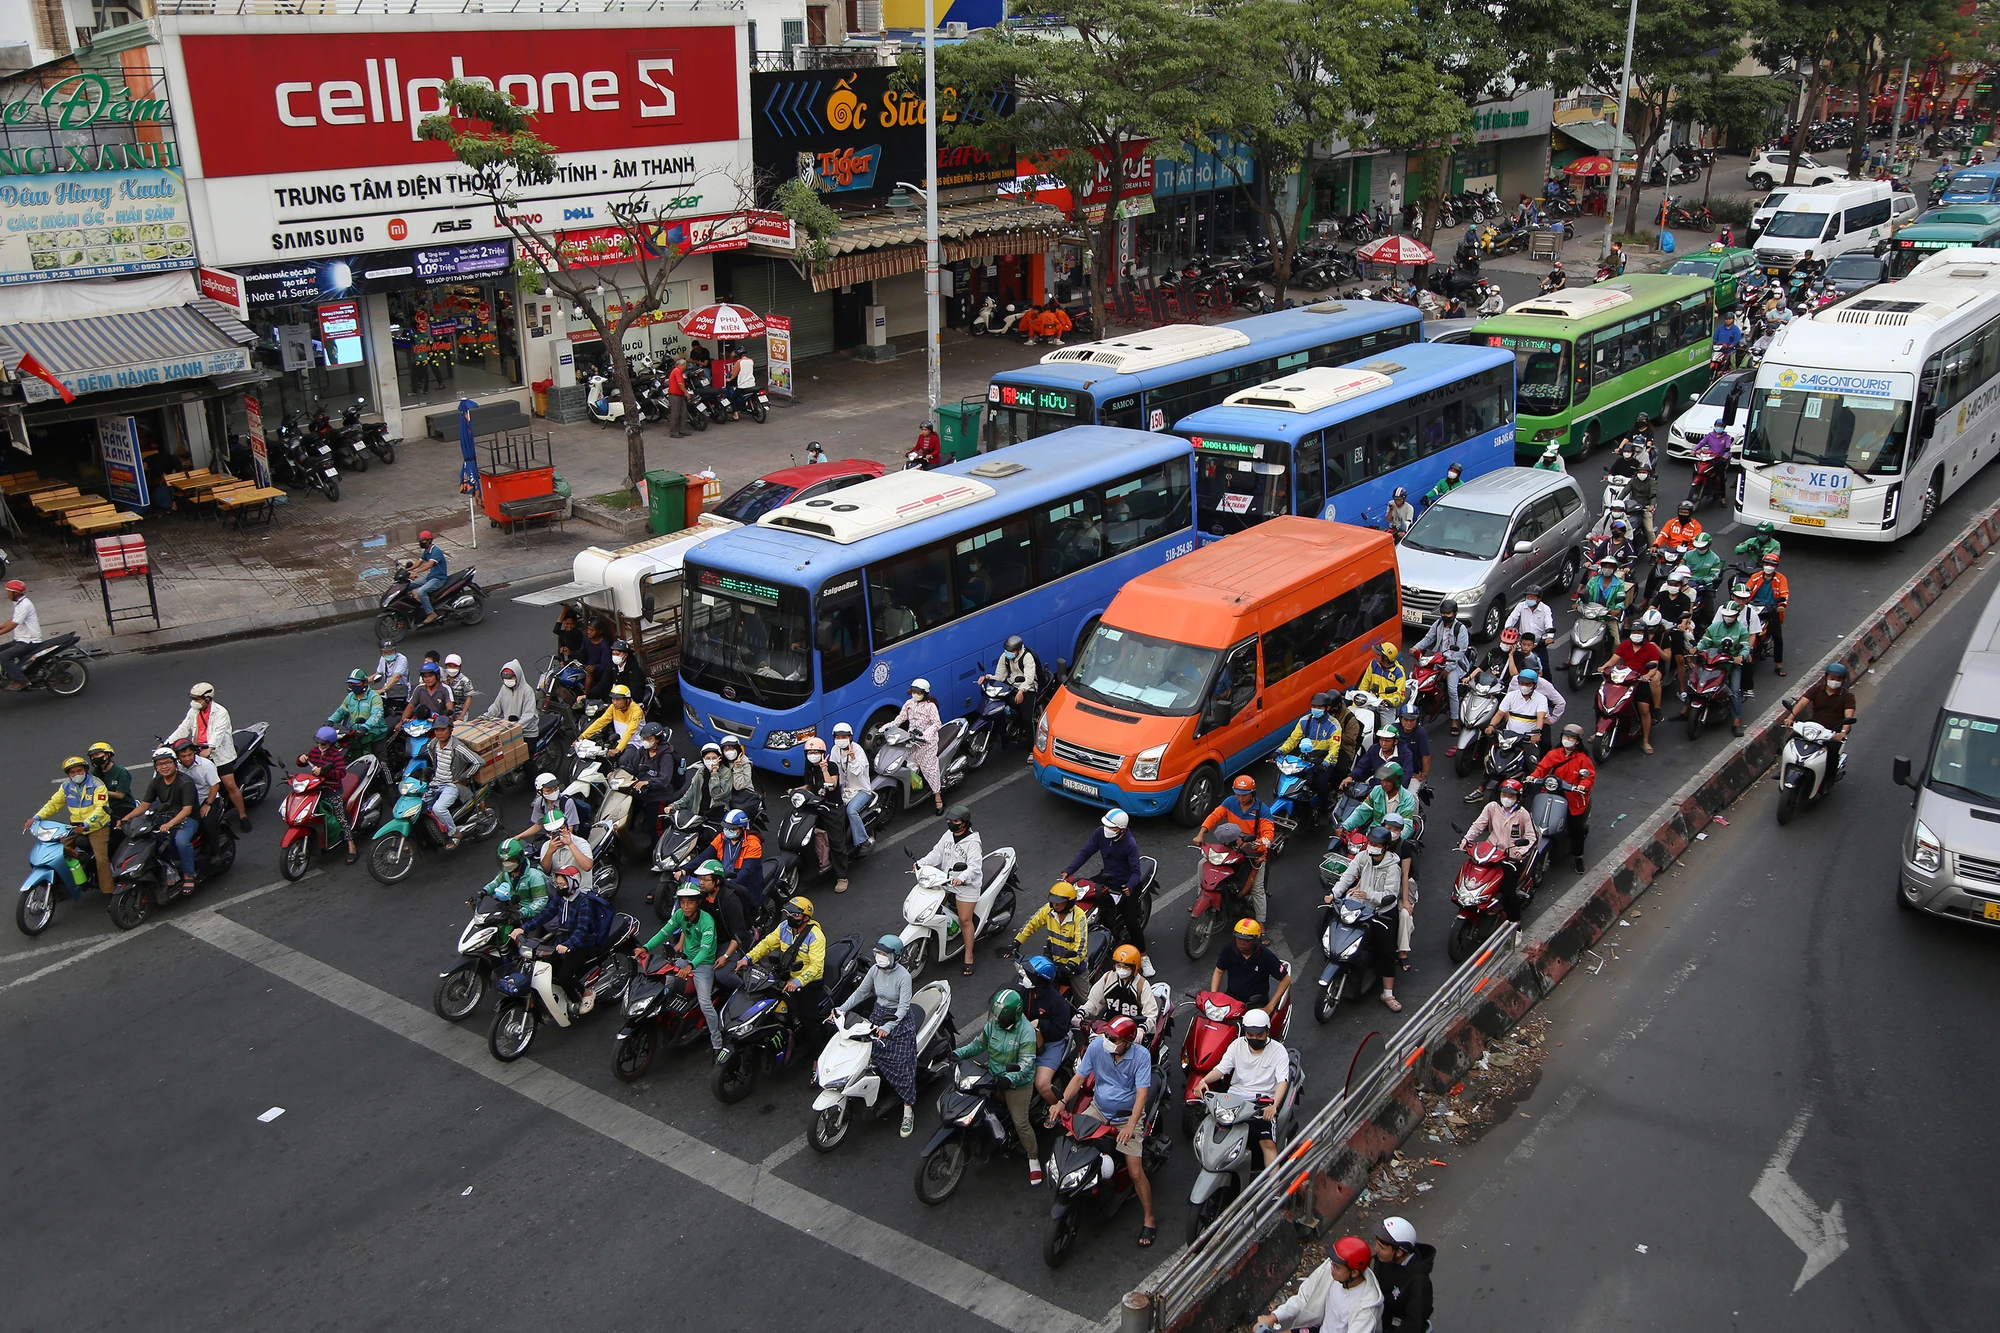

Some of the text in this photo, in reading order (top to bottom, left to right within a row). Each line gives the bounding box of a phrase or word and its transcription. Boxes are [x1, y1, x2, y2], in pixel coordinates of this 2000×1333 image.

[62, 141, 178, 173] XANH
[817, 148, 873, 186] Tiger
[275, 184, 346, 208] TRUNG
[350, 178, 392, 203] TÂM
[397, 174, 443, 199] ĐIỆN
[558, 161, 597, 183] TÍNH
[613, 158, 637, 179] ÂM
[641, 156, 695, 176] THANH
[7, 203, 175, 231] CÁC MÓN ỐC HẢI SẢN
[564, 207, 594, 221] DELL
[272, 225, 365, 250] SAMSUNG
[481, 247, 505, 257] 2 Triệu
[75, 267, 96, 276] BÌNH
[97, 265, 125, 275] THẠNH
[417, 263, 437, 275] 1.09
[251, 291, 276, 303] Note
[276, 289, 288, 300] 14
[290, 286, 319, 298] Series
[695, 315, 715, 325] ĐỒNG
[720, 316, 740, 332] PHỤ KIỆN
[77, 372, 114, 392] ĐÊM
[119, 367, 159, 389] HÀNG
[164, 361, 204, 379] XANH
[1800, 373, 1892, 391] SAIGONTOURIST
[1112, 398, 1134, 410] SAMCO
[1808, 401, 1819, 416] 01
[1151, 412, 1163, 429] 150
[1191, 436, 1203, 448] 52
[104, 445, 132, 463] XANH
[1809, 472, 1848, 489] XE 01
[823, 578, 859, 598] SaigonBus
[1121, 1003, 1138, 1017] 26
